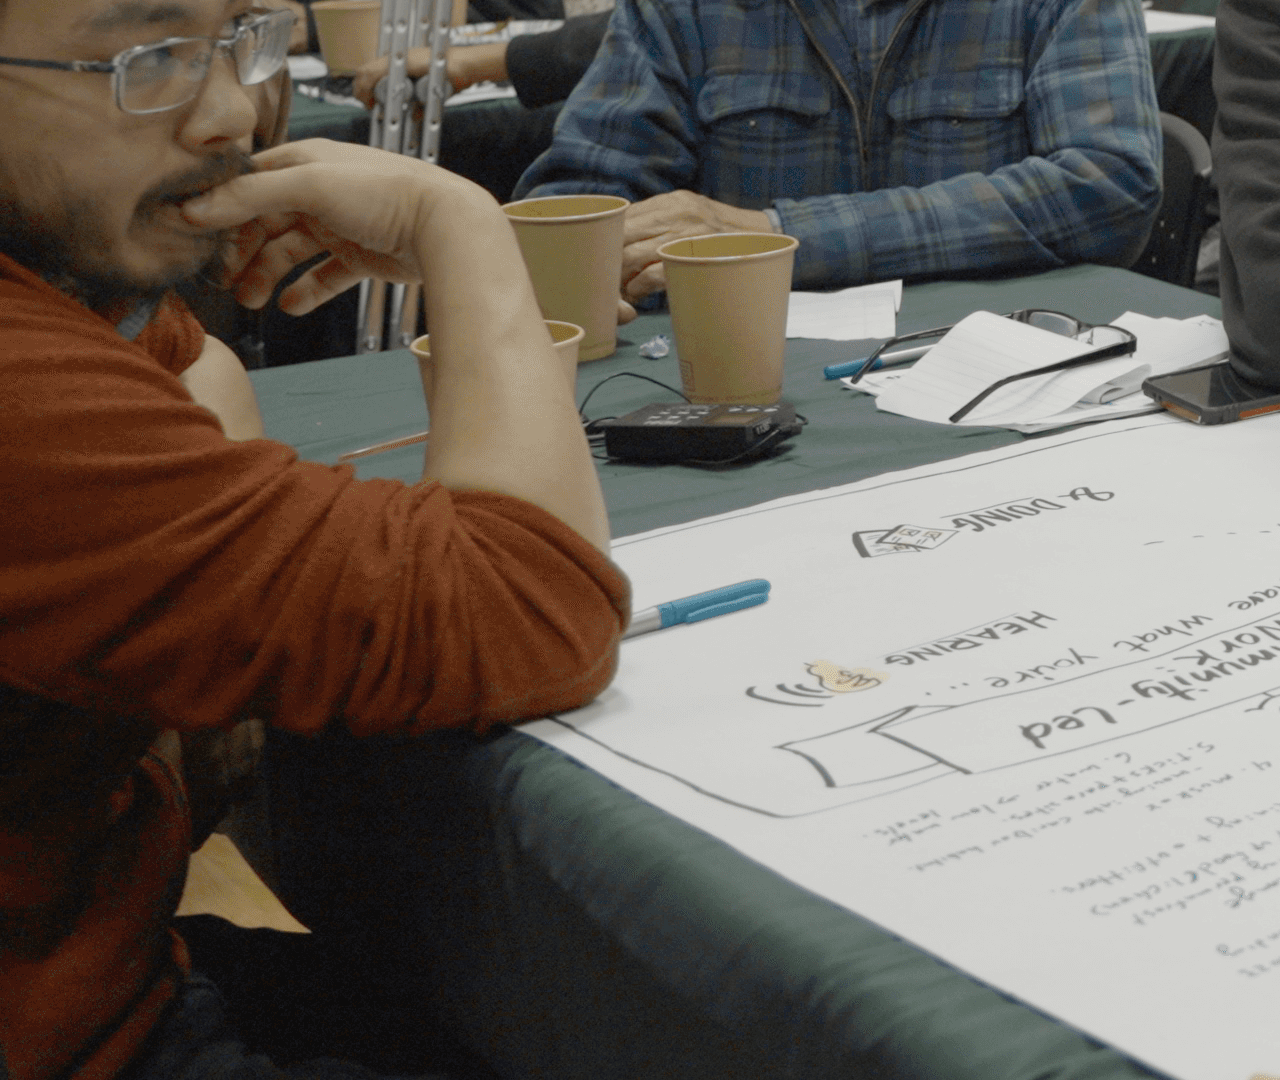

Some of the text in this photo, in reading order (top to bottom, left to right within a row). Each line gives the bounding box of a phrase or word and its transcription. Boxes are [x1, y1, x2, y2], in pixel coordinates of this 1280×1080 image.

[952, 498, 1067, 533] DOING
[885, 611, 1056, 665] HEARING
[1113, 615, 1213, 652] what
